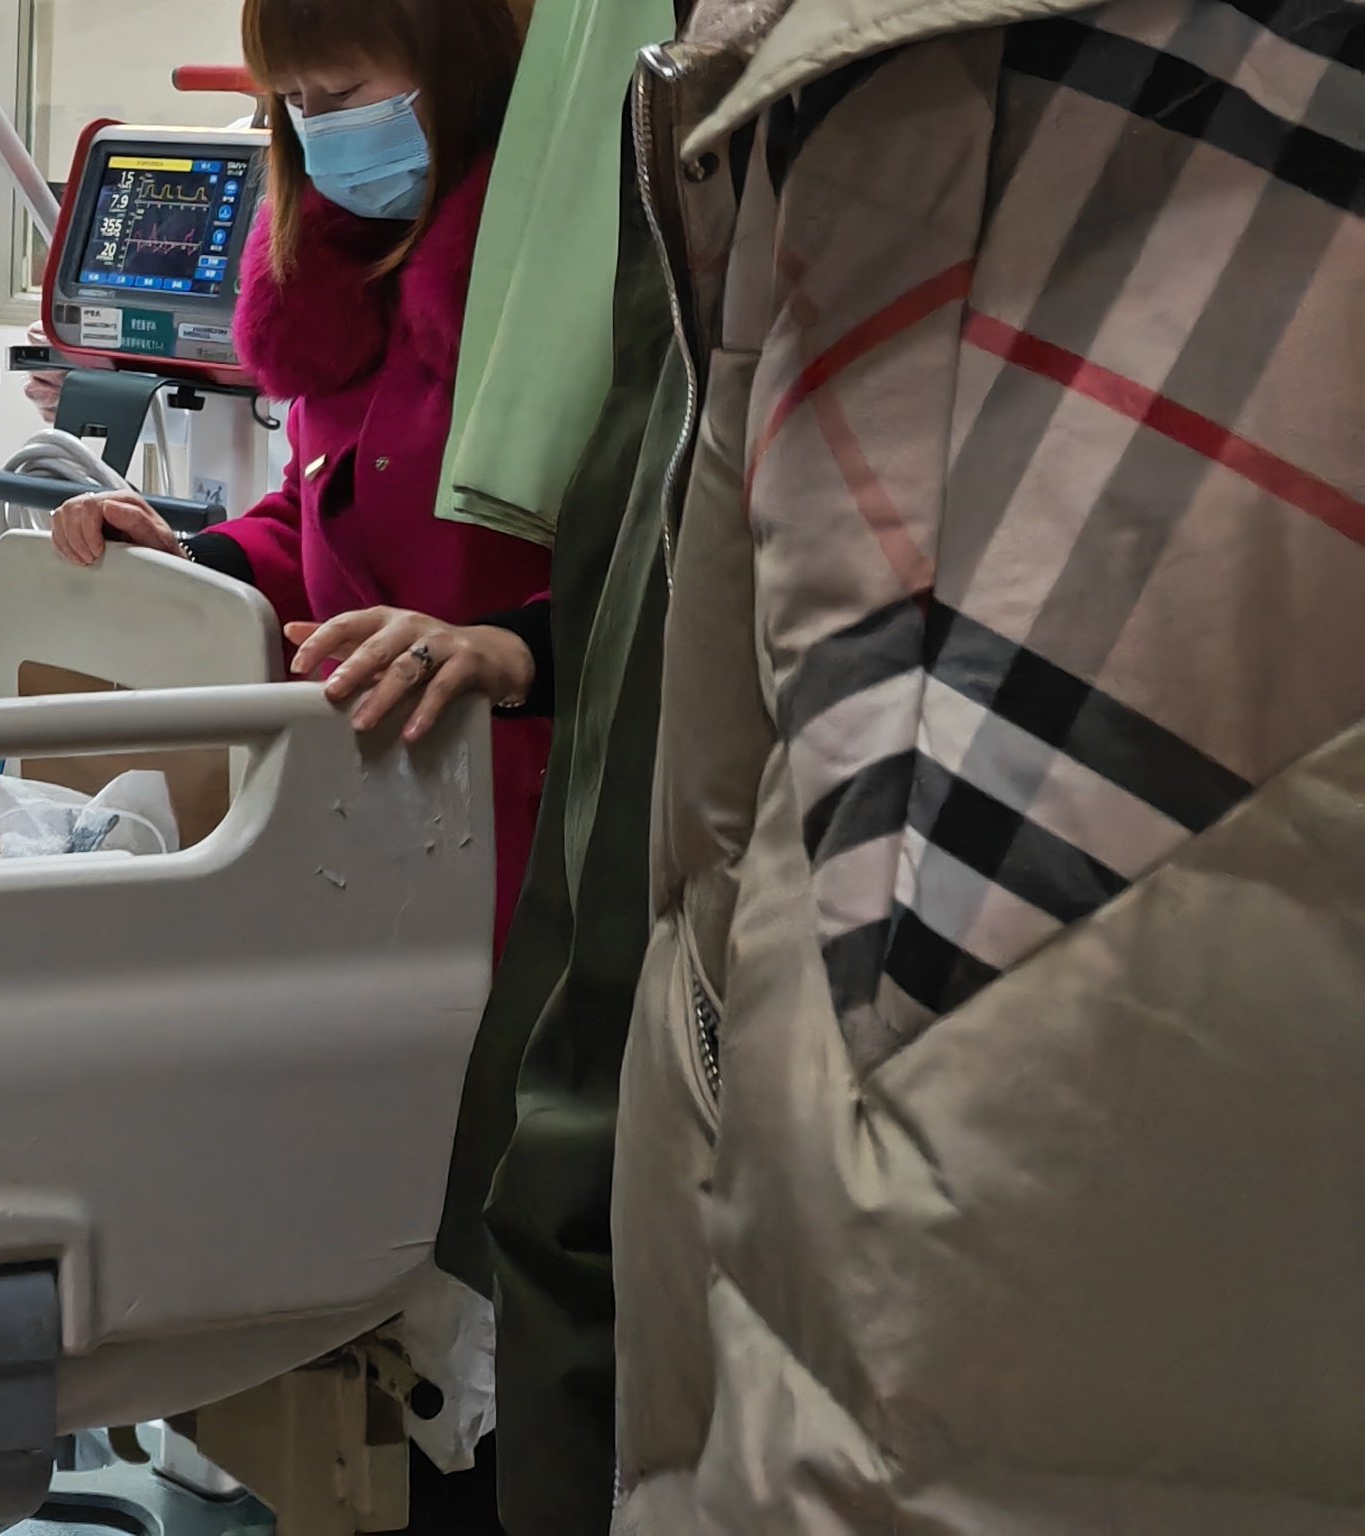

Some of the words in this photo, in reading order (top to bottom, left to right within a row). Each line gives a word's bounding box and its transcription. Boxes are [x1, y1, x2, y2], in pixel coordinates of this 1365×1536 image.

[111, 194, 129, 208] 7.9
[101, 218, 122, 232] 355
[101, 242, 116, 256] 20
